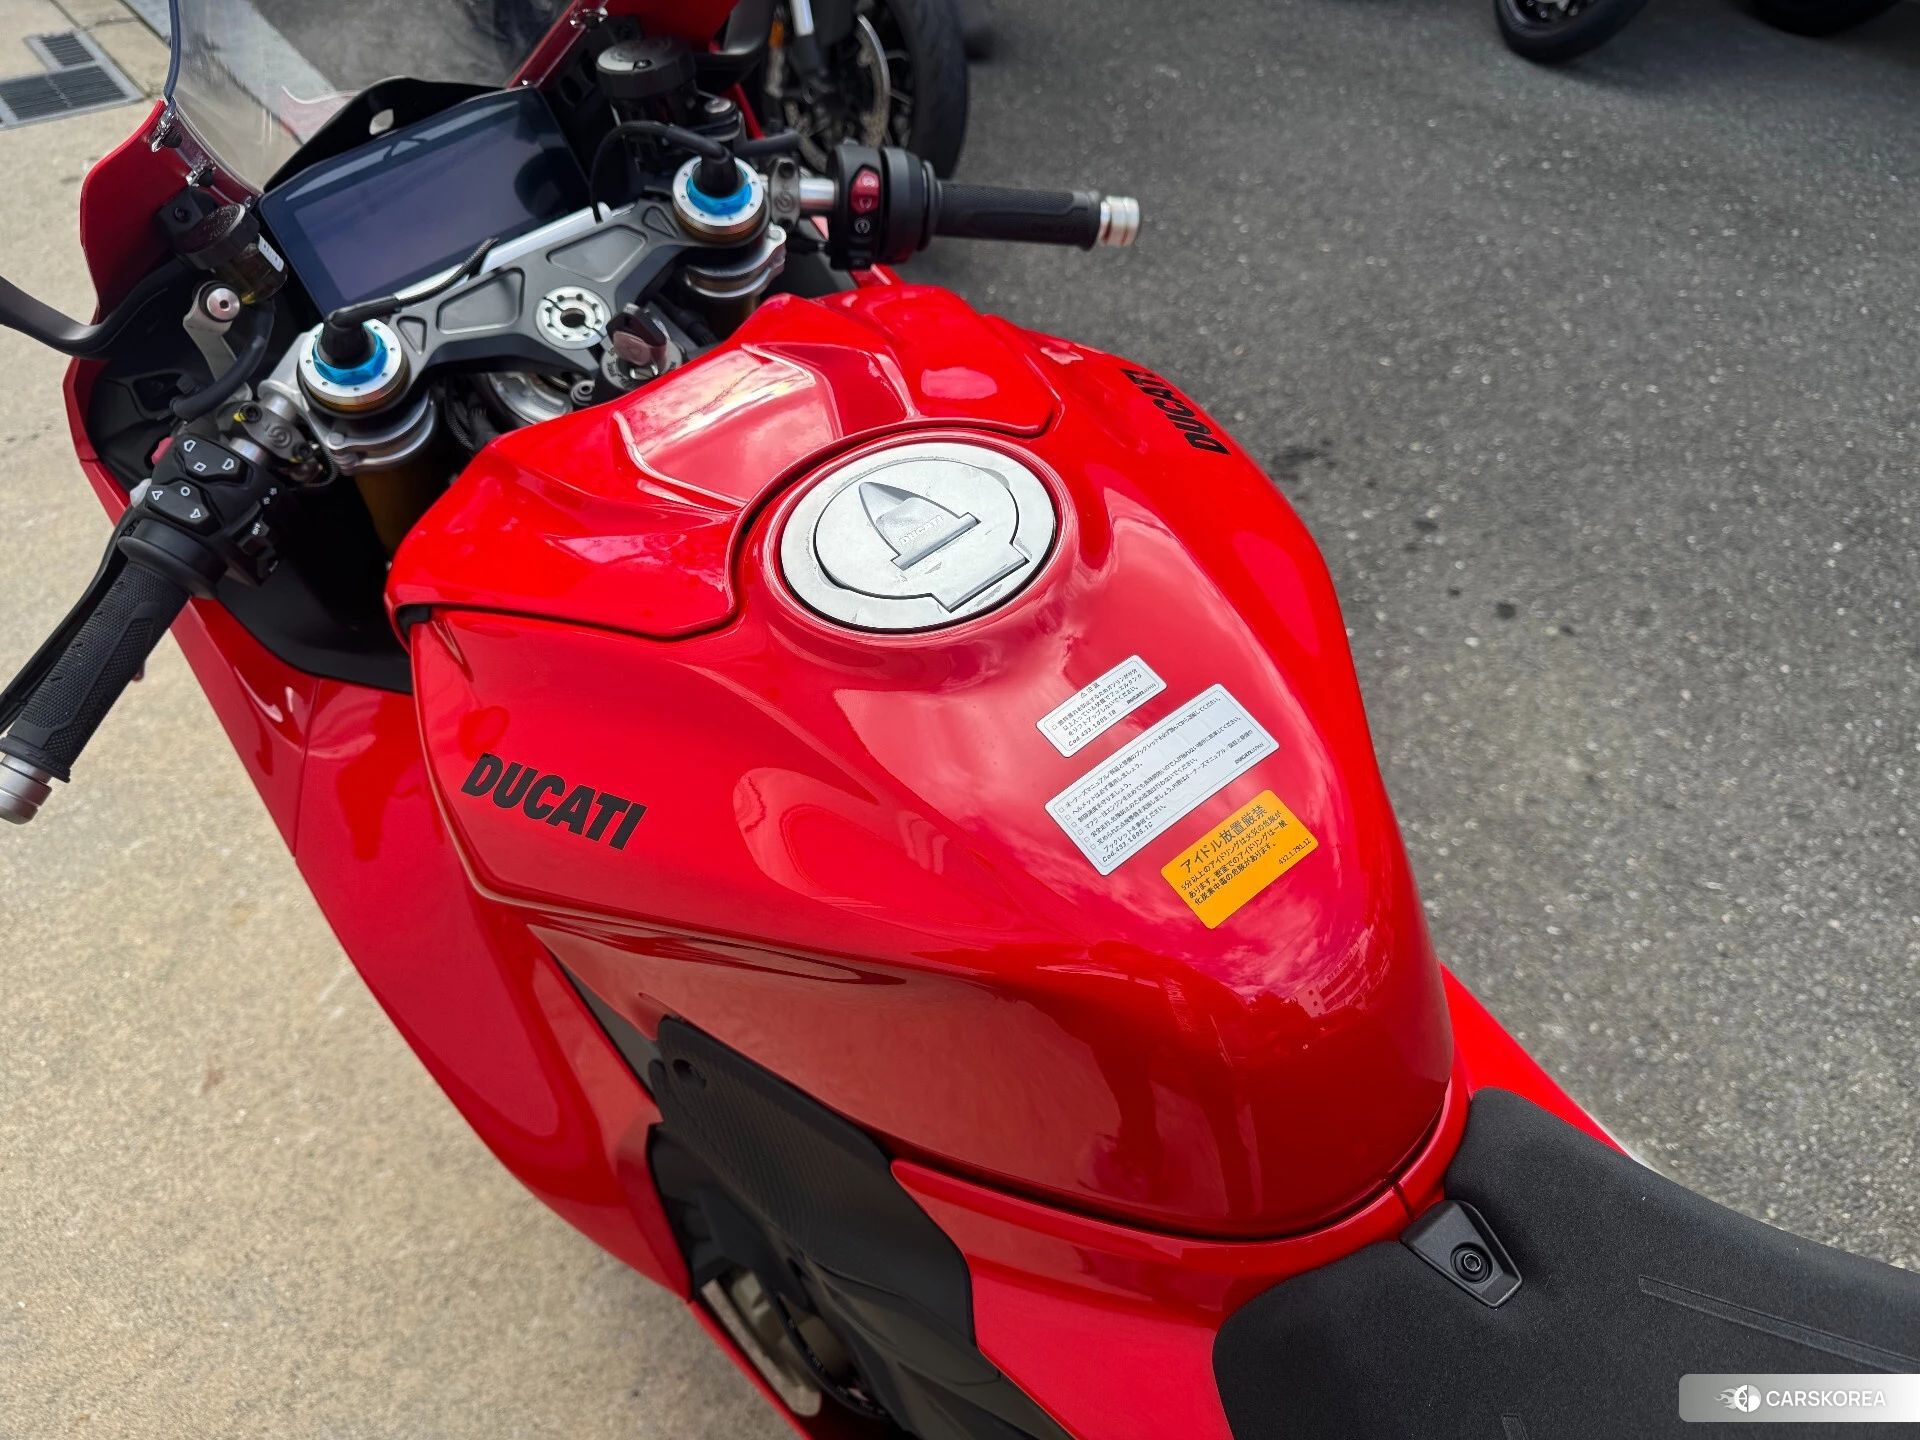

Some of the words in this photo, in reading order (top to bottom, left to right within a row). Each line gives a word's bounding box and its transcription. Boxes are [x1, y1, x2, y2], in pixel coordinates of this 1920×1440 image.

[1120, 368, 1231, 456] DUCATI
[899, 515, 944, 546] DUCATI
[461, 752, 648, 850] DUCATI
[1179, 804, 1267, 873] アイドル放置厳禁
[1180, 809, 1281, 890] 5分以上のアイドリングは火災の危険が
